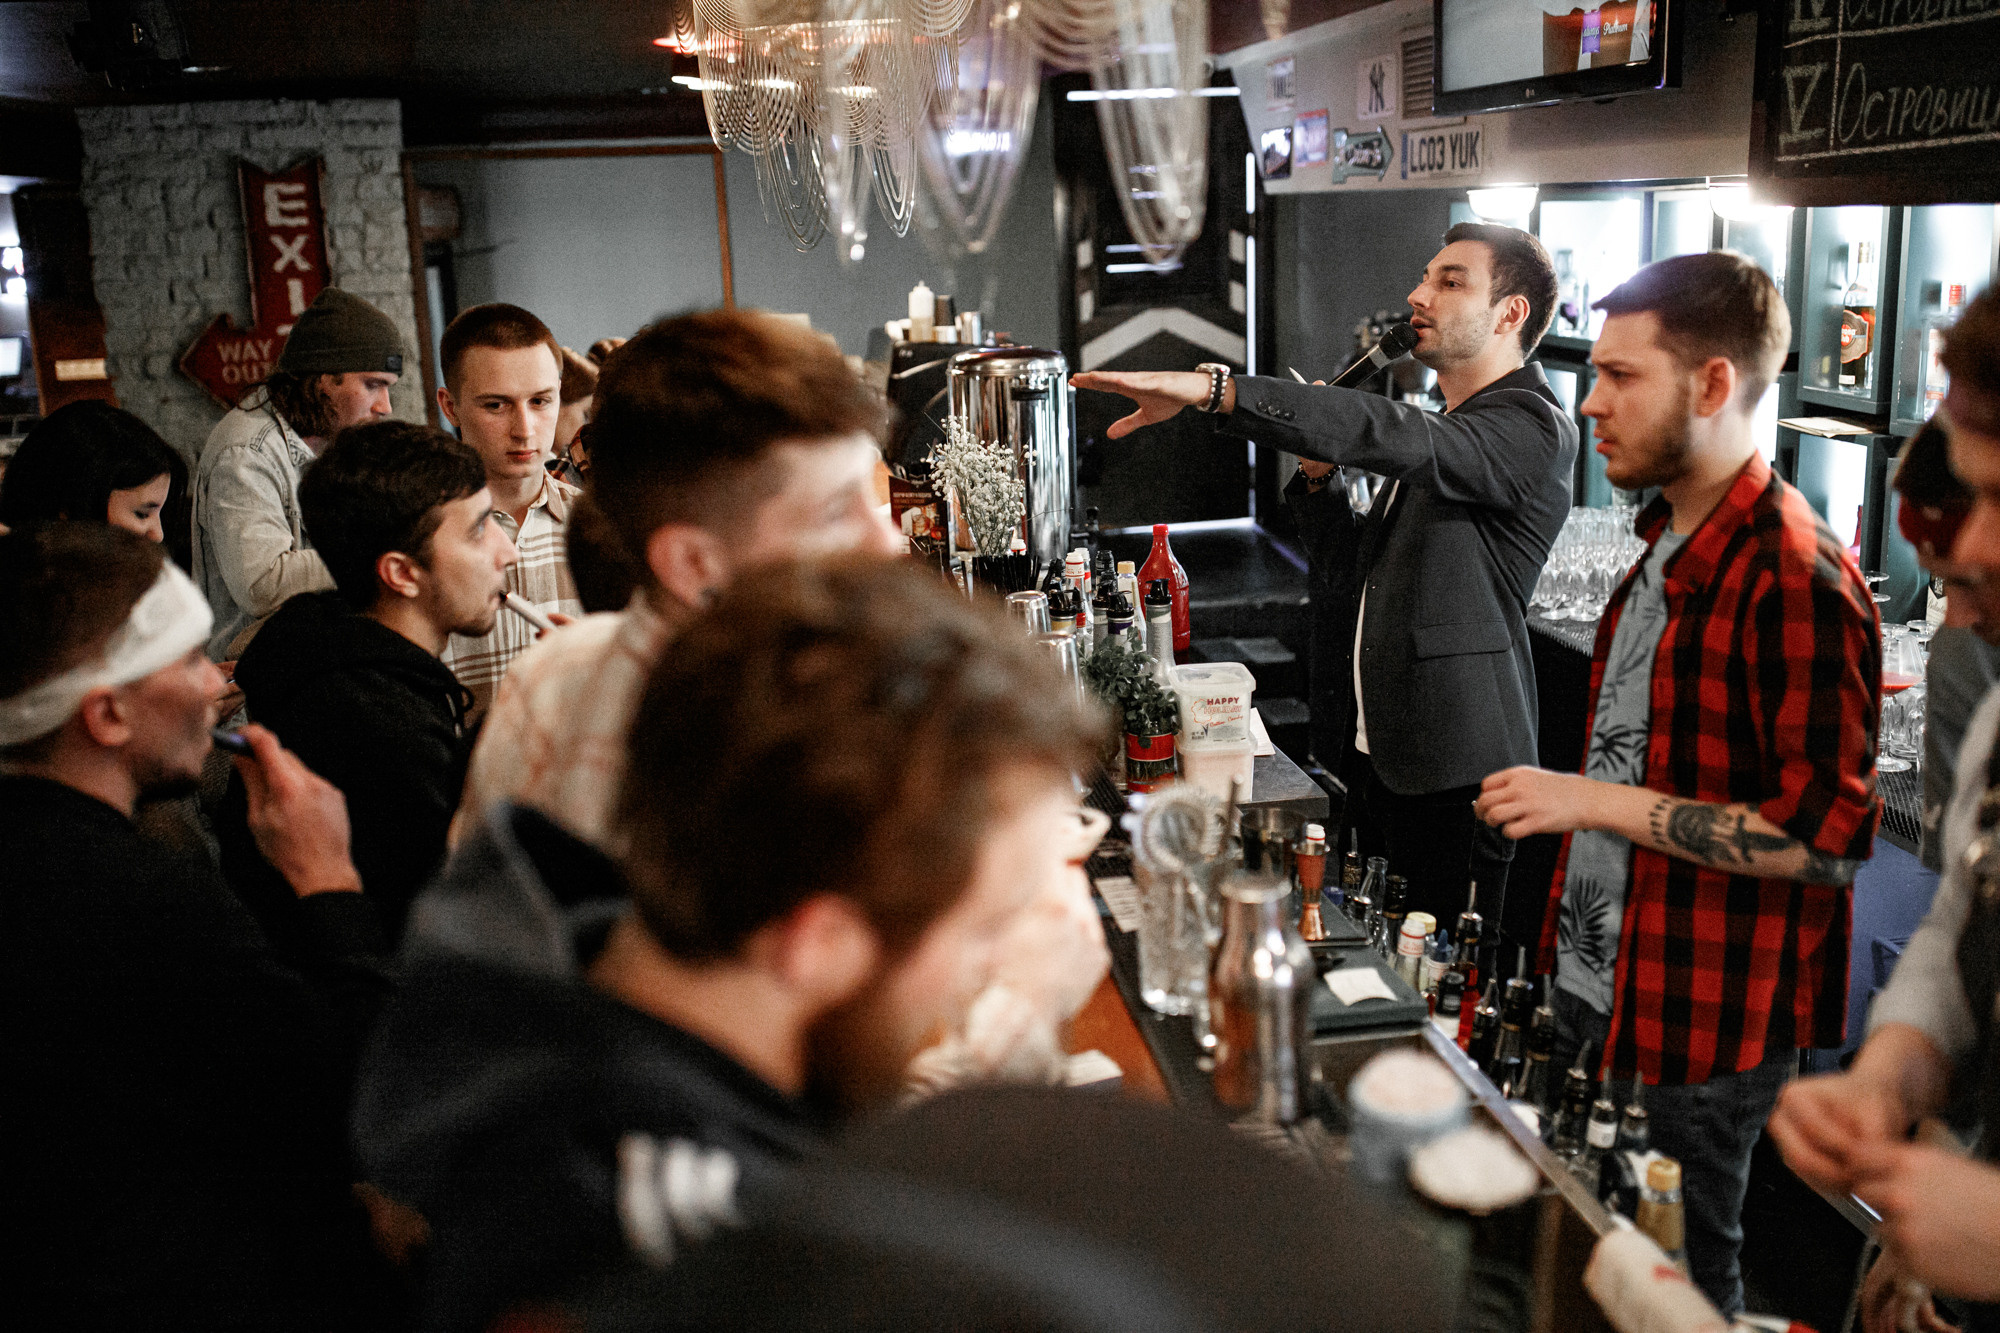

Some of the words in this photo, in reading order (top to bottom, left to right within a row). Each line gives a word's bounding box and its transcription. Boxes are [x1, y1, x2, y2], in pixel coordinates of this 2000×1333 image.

[1410, 135, 1445, 173] LC03
[1449, 131, 1479, 171] YUK
[218, 340, 272, 362] WAY
[1206, 697, 1239, 705] HAPPY
